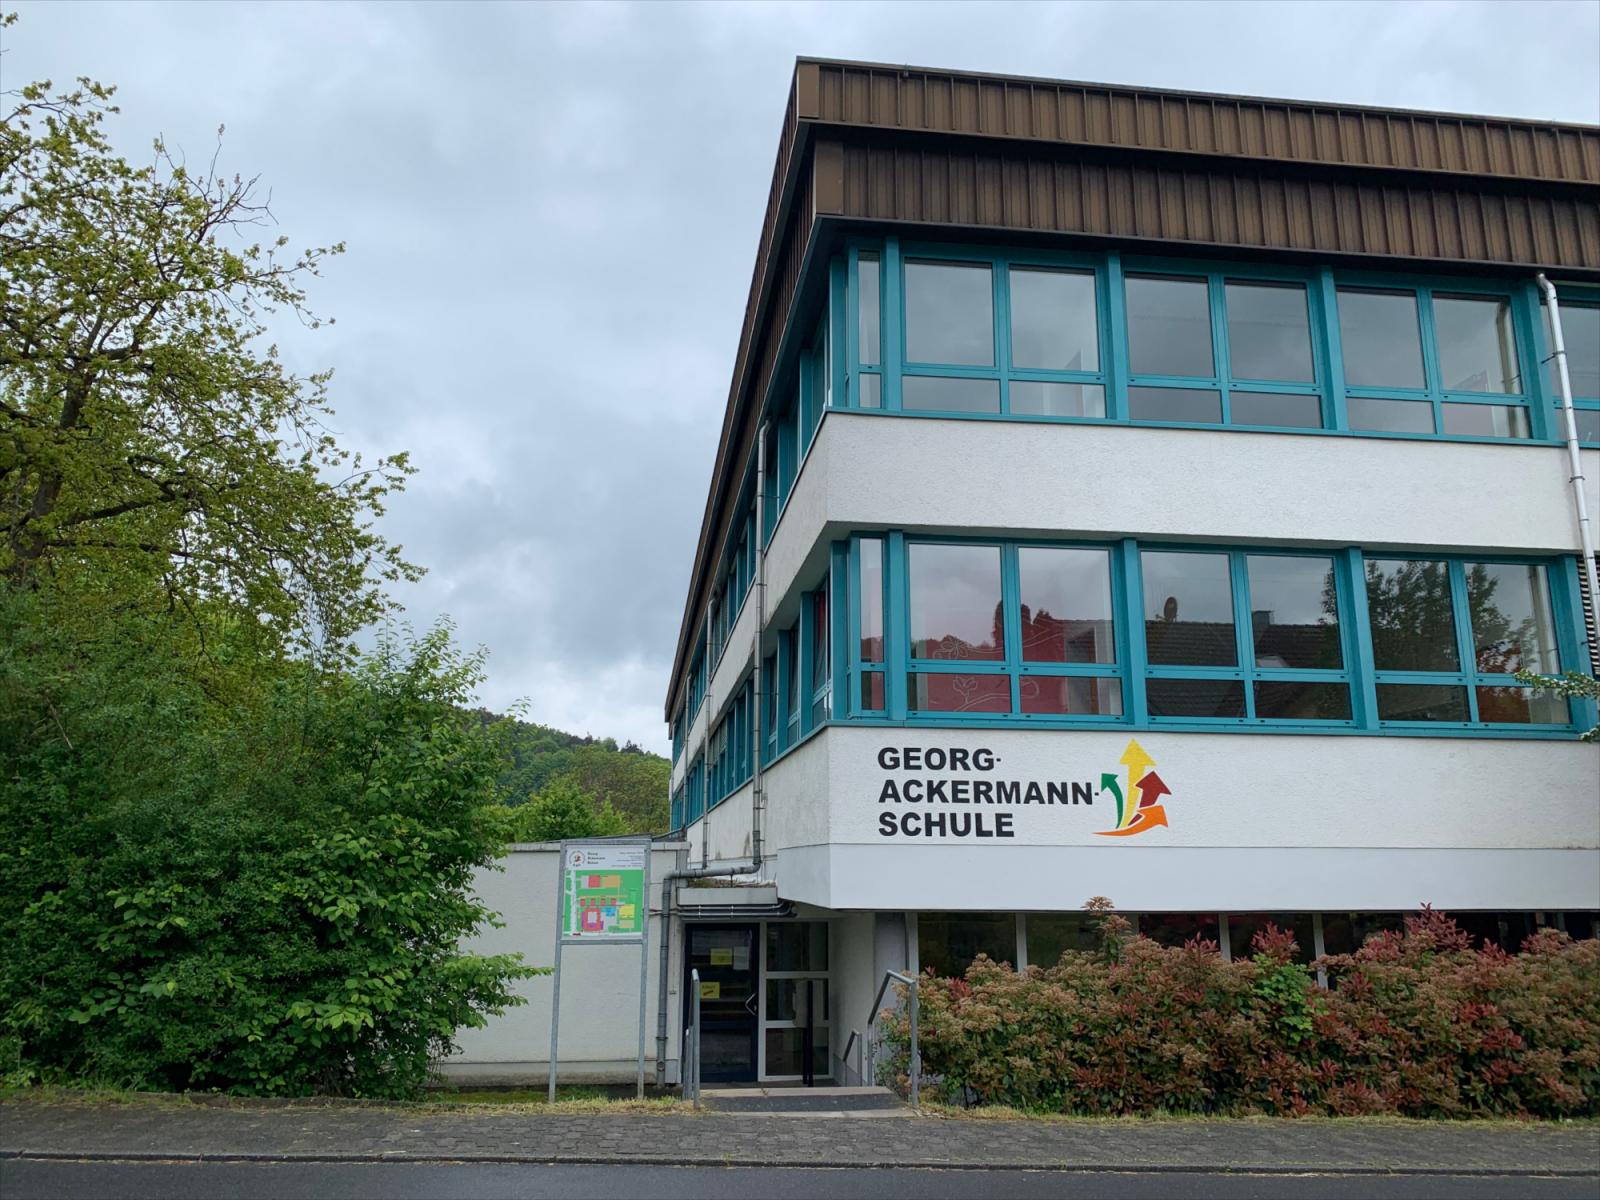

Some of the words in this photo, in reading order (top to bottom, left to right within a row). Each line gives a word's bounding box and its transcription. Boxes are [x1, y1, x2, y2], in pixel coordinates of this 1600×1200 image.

[877, 747, 1002, 771] GEORG-
[878, 779, 1100, 805] ACKERMANN-
[878, 811, 1015, 837] SCHULE
